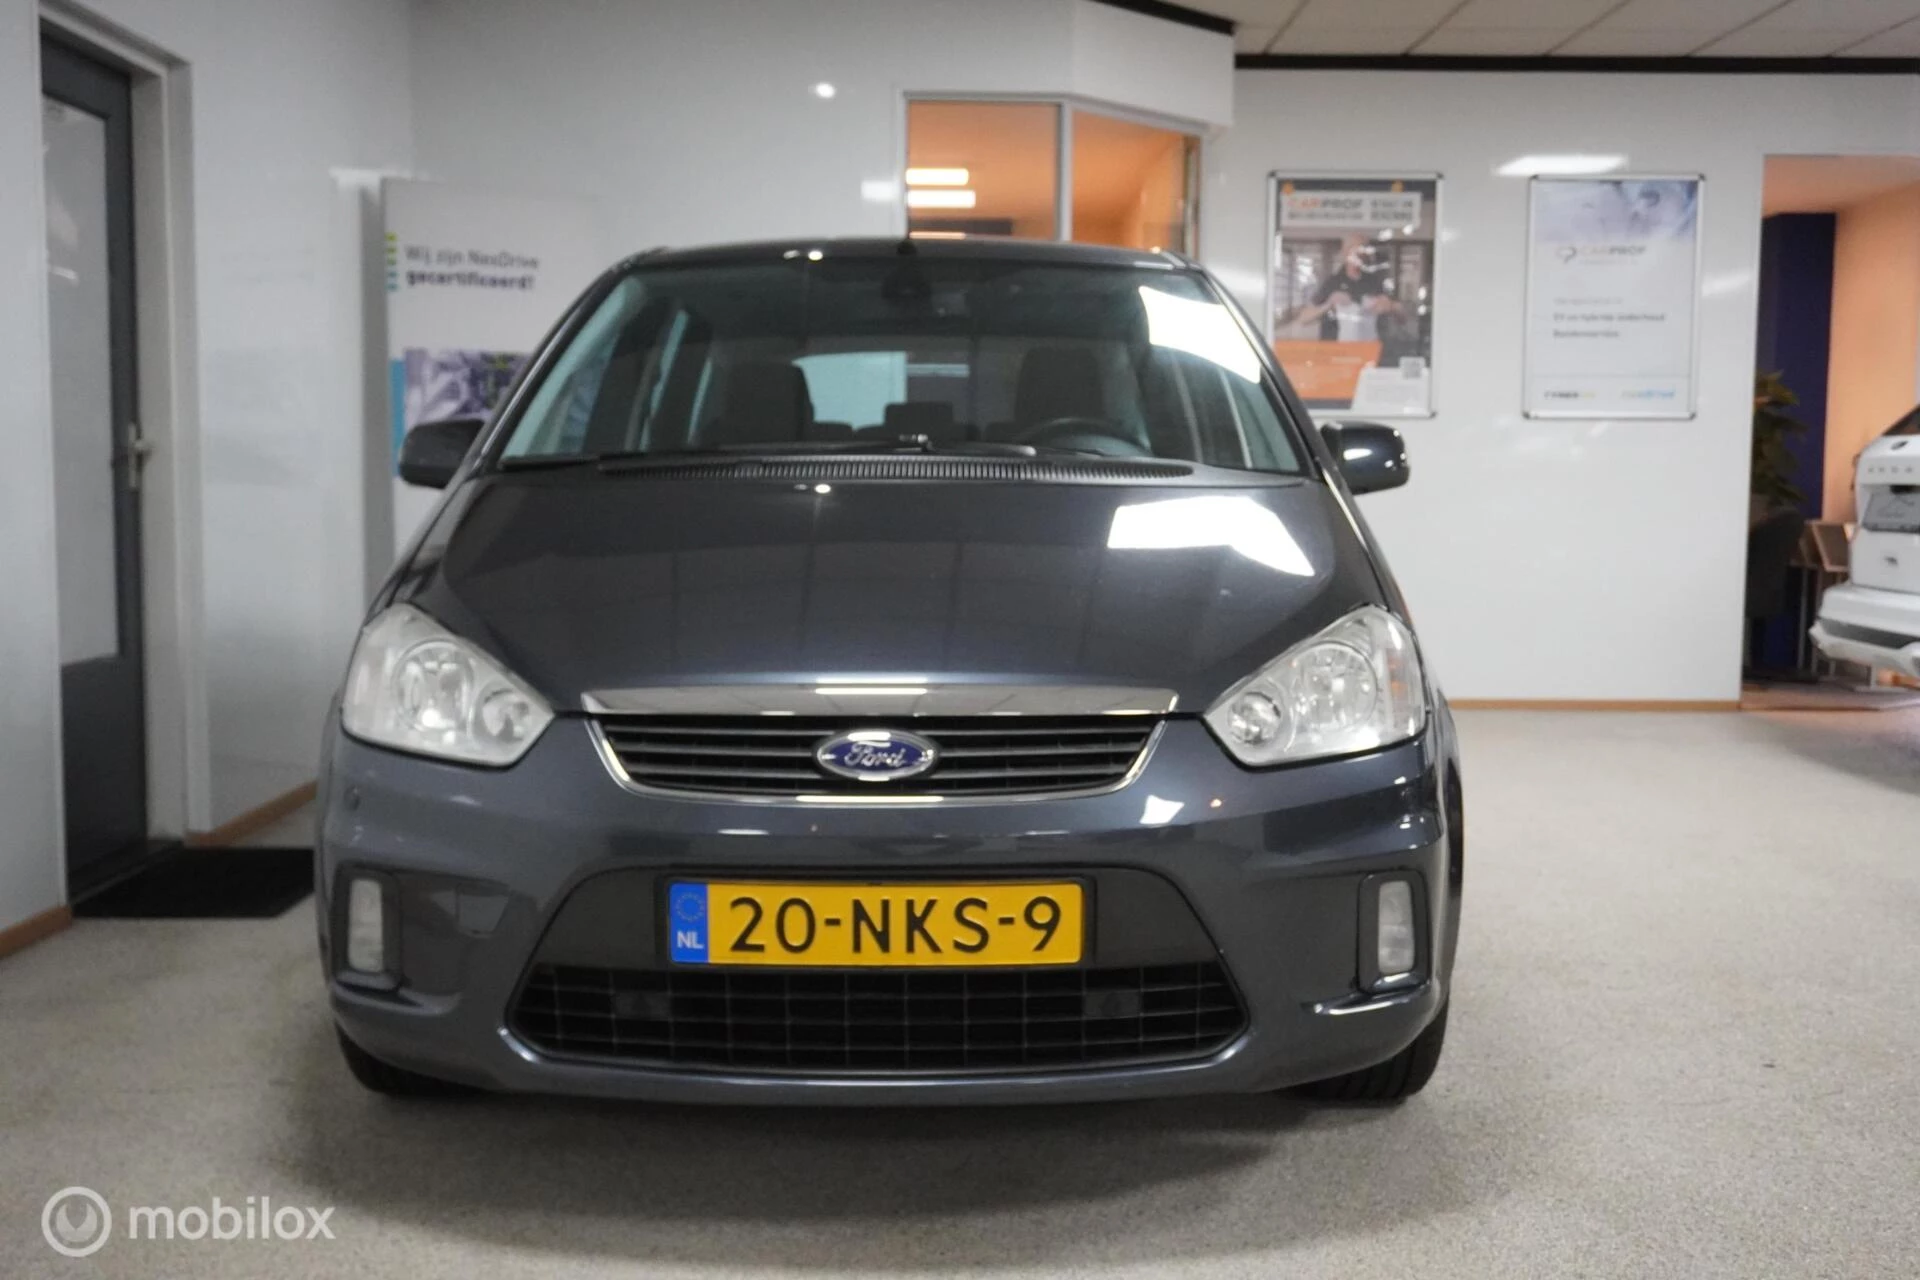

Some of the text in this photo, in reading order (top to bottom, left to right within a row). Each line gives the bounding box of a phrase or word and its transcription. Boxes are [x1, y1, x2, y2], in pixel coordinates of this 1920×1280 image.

[405, 245, 430, 264] Wij
[436, 249, 463, 266] zijn
[844, 743, 906, 768] Ford
[730, 896, 1062, 954] 20-NKS-9
[677, 932, 704, 949] NL
